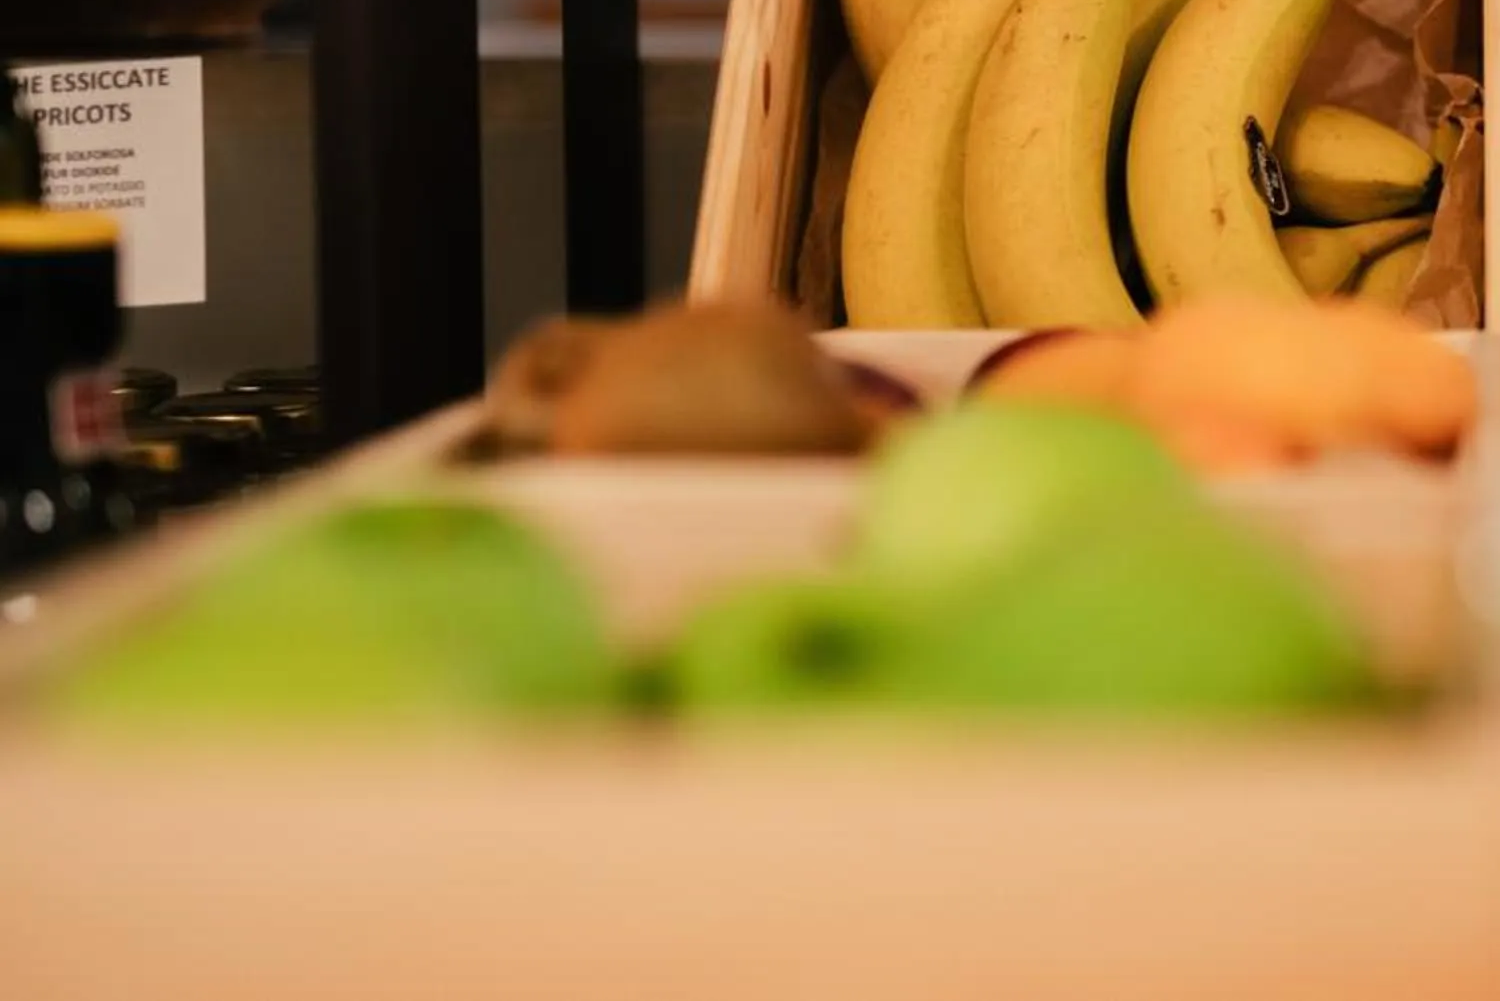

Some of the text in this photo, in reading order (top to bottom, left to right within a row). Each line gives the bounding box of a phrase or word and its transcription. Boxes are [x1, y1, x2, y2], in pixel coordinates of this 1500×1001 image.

[15, 68, 170, 95] HE ESSICCATE
[34, 103, 132, 127] PRICOTS
